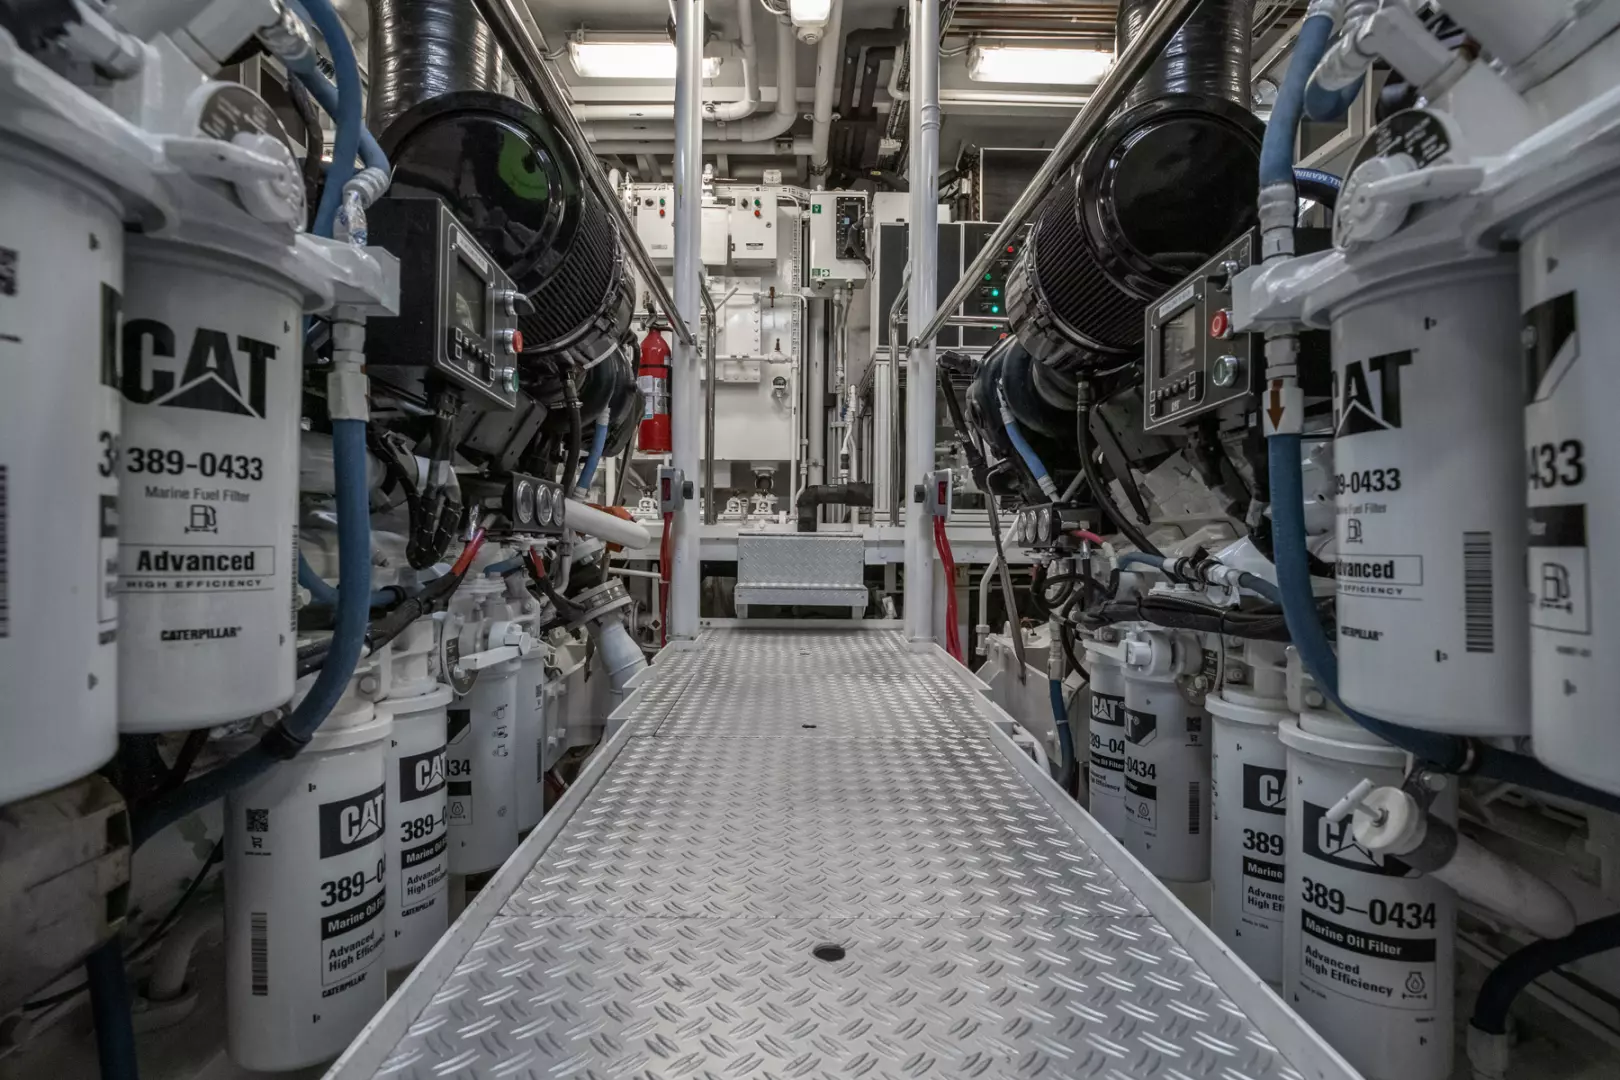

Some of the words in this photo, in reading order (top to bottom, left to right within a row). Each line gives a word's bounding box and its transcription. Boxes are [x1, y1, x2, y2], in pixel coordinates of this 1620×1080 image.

[121, 318, 277, 420] CAT
[126, 446, 264, 482] 389-0433
[145, 486, 190, 501] Marine
[193, 488, 220, 501] Fuel
[223, 489, 251, 503] Filter
[136, 549, 256, 573] Advanced
[126, 580, 168, 589] HIGH
[174, 578, 263, 589] EFFICIENCY
[406, 847, 434, 864] Marine
[1247, 862, 1284, 880] Marine
[407, 882, 426, 896] High
[1247, 896, 1270, 911] High
[1301, 876, 1437, 931] 389-0434
[328, 911, 366, 933] Marine
[329, 929, 375, 960] Advanced
[1304, 917, 1344, 945] Marine
[1346, 933, 1366, 950] Oil
[1368, 939, 1403, 956] Filter
[329, 956, 354, 973] High
[1305, 945, 1360, 976] Advanced
[1305, 959, 1328, 977] High
[1331, 969, 1394, 998] Efficiency
